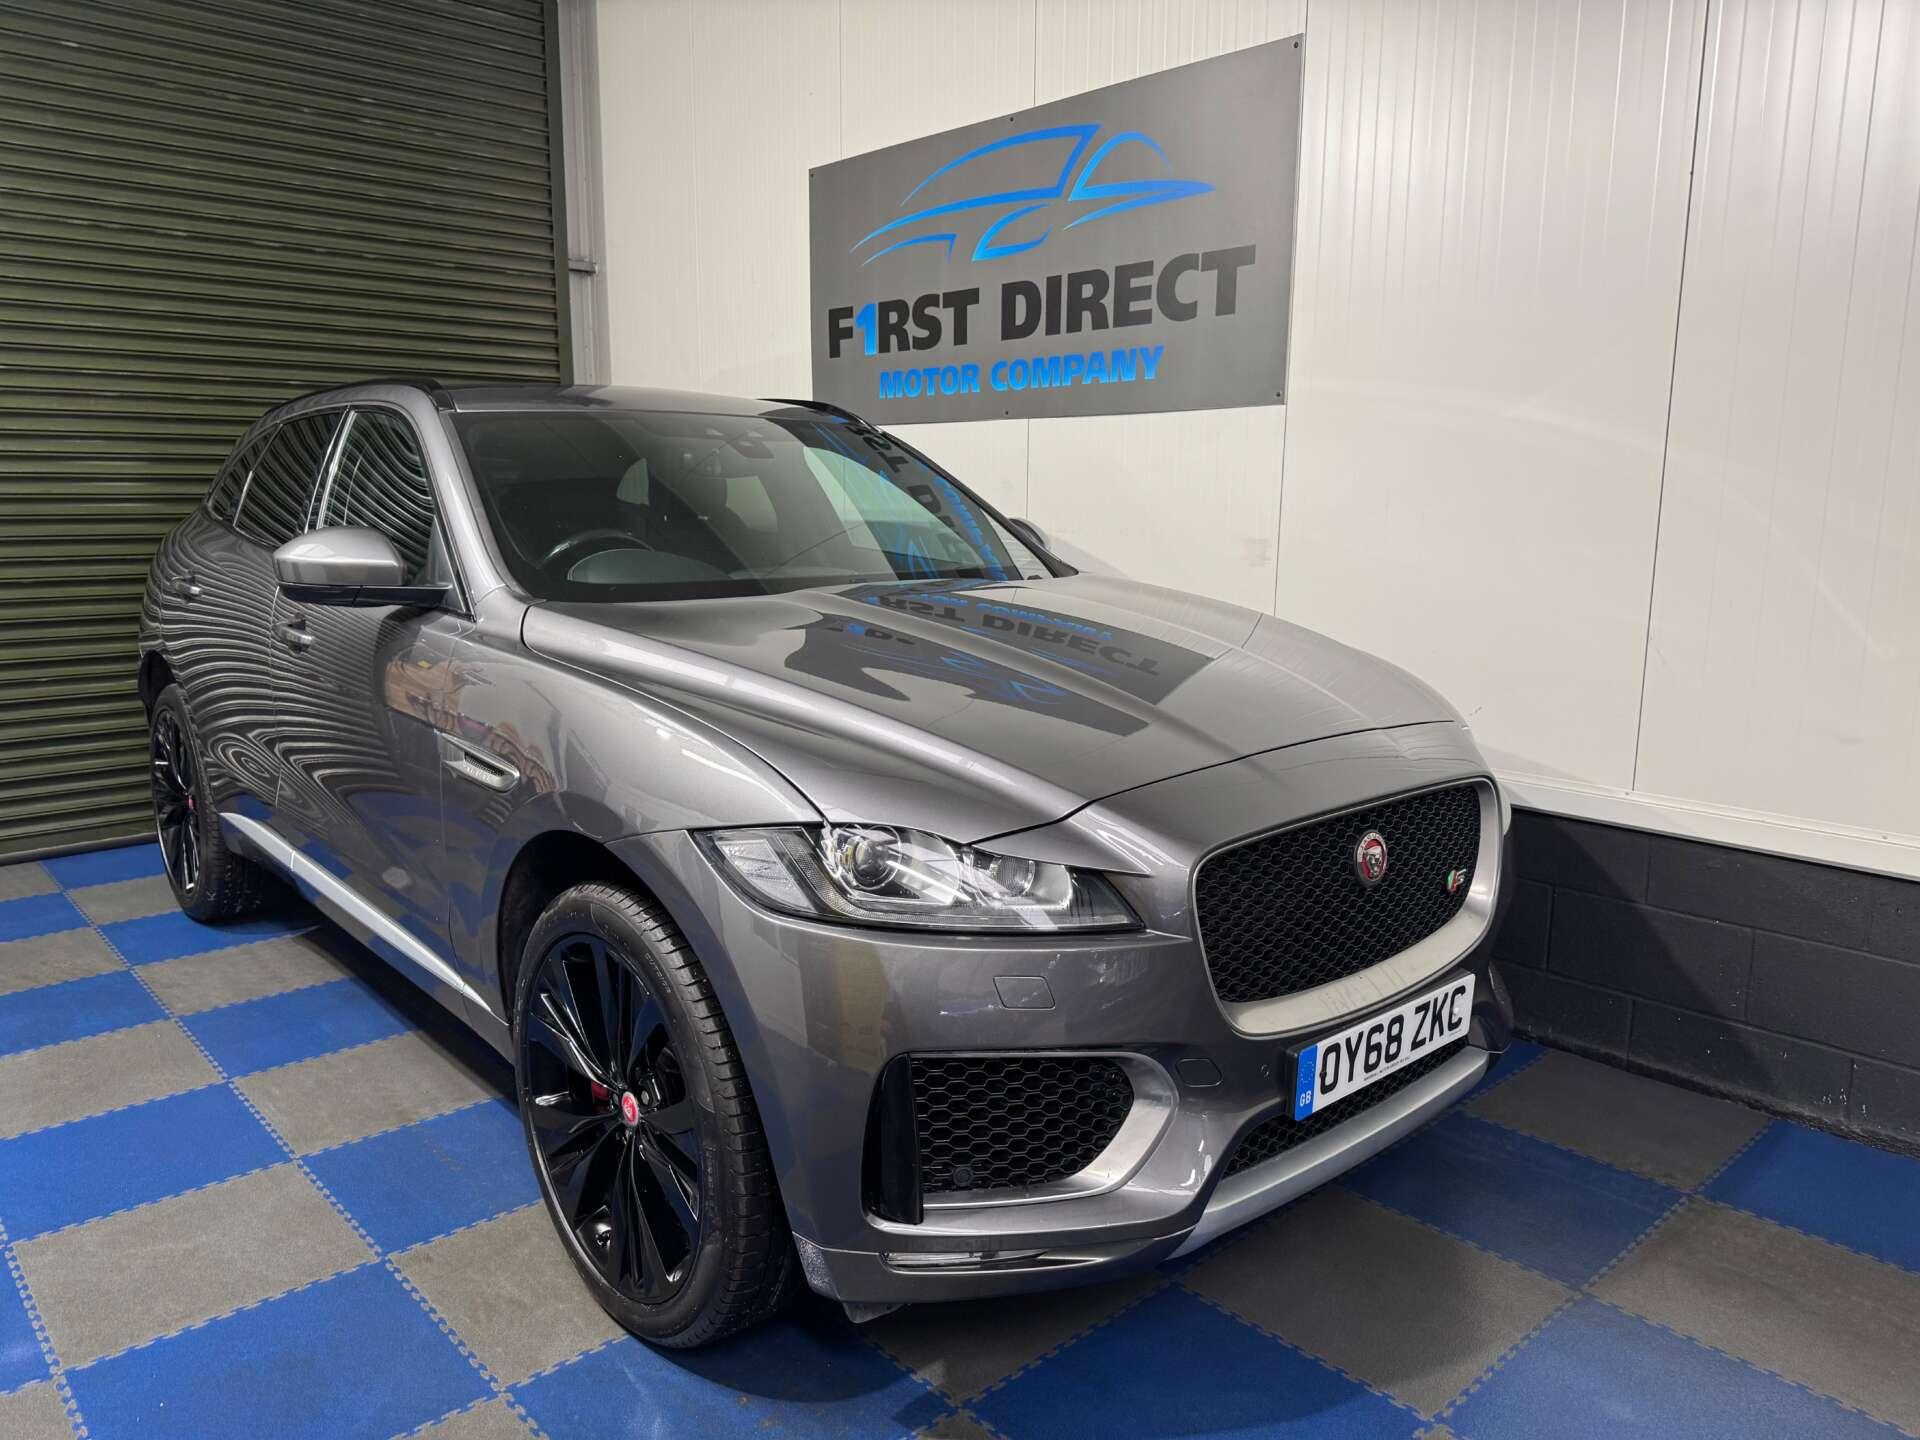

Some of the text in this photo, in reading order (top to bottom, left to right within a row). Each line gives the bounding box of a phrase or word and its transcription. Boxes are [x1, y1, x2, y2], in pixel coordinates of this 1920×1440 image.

[828, 244, 1256, 358] F1RST DIRECT
[879, 344, 1165, 399] MOTOR COMPANY
[1318, 985, 1467, 1095] OY68 ZKC
[1299, 1090, 1312, 1107] GB
